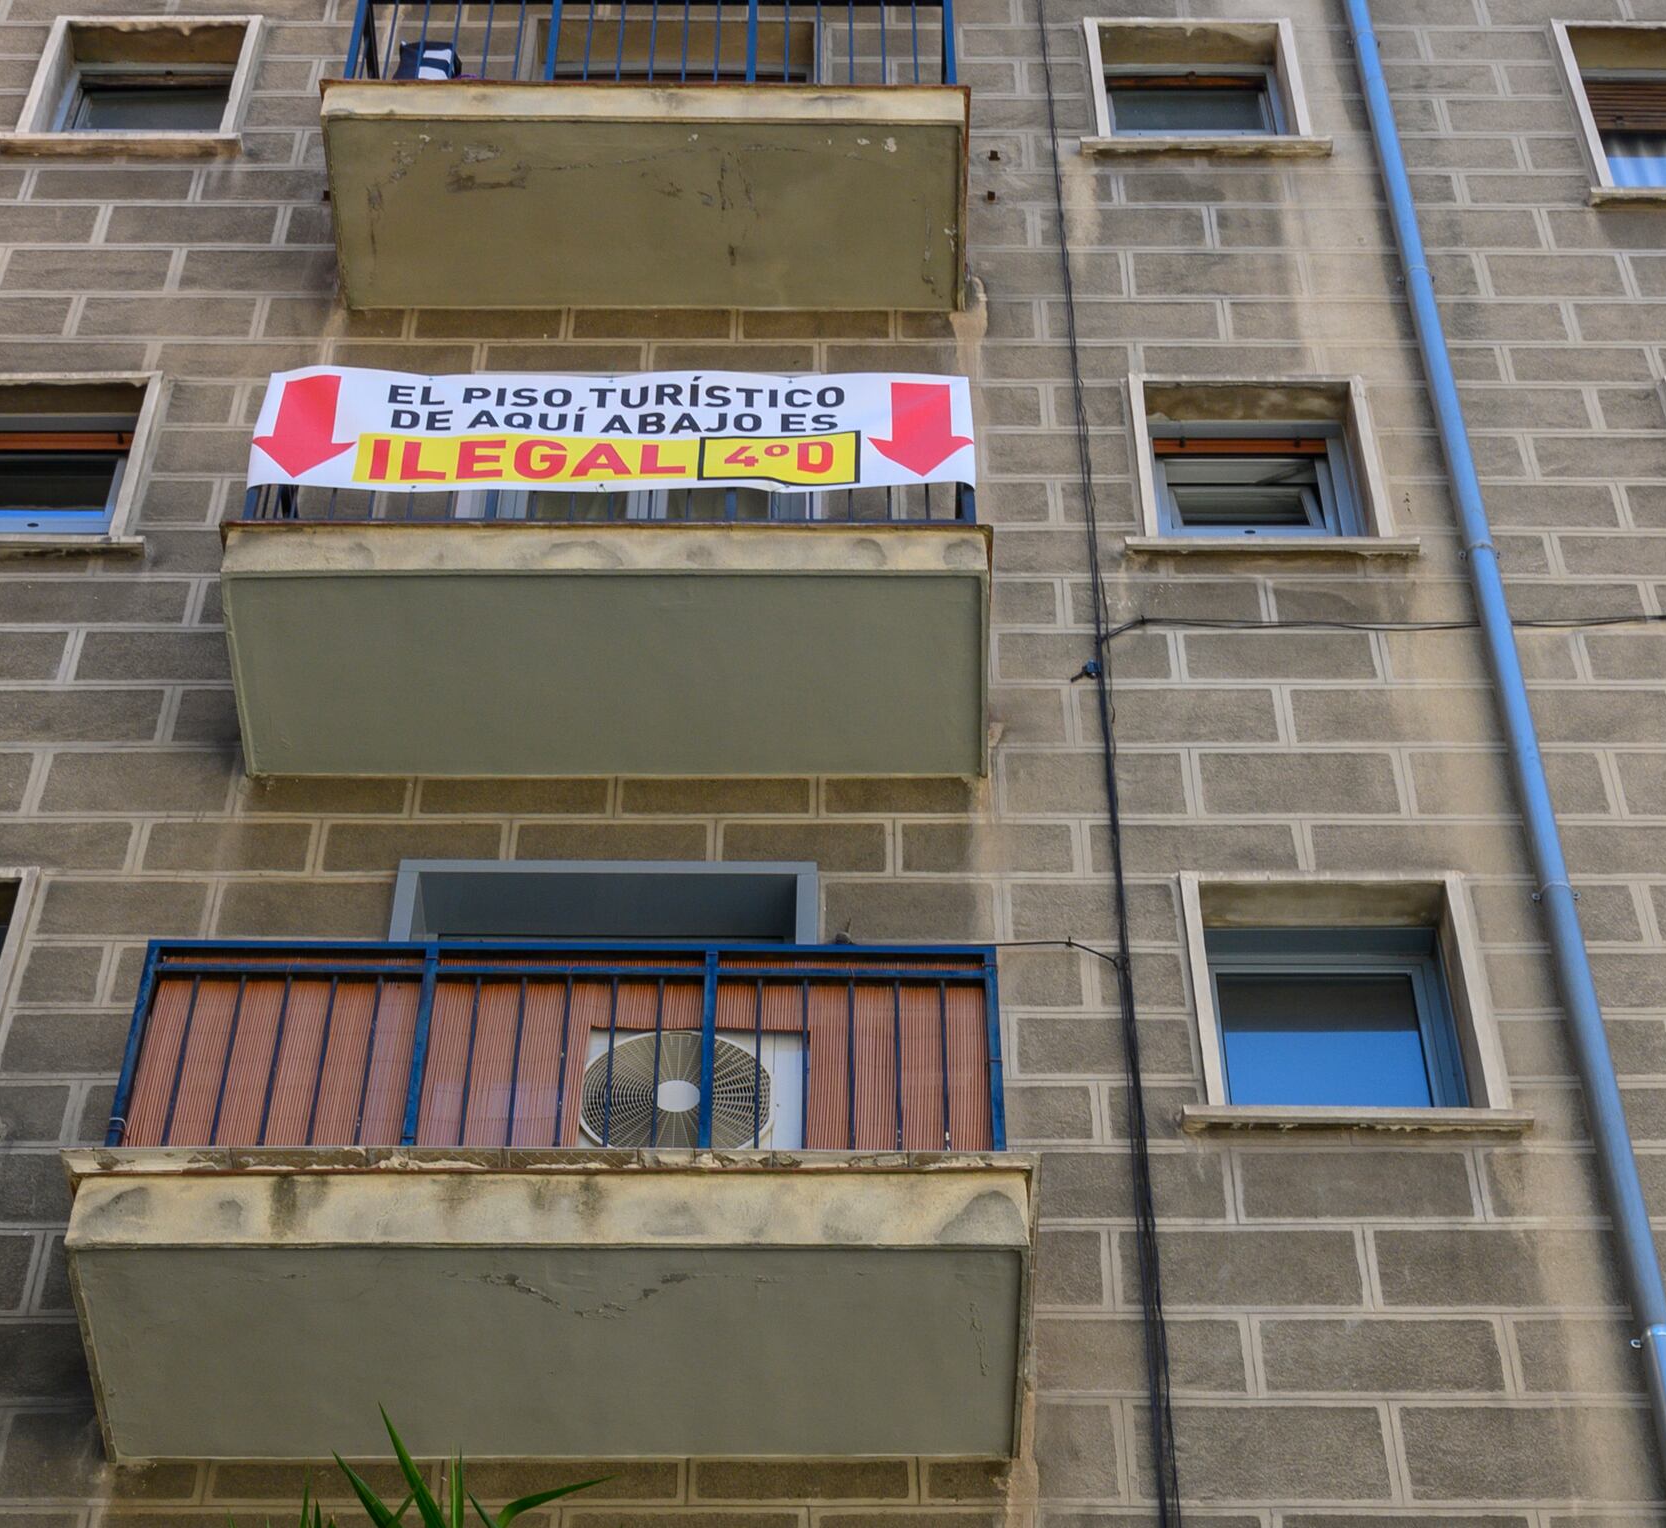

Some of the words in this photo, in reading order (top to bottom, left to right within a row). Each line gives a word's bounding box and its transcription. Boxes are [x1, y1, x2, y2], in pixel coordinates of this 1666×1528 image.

[387, 384, 446, 406] EL
[462, 387, 573, 408] PISO
[588, 376, 846, 409] TURÍSTICO
[390, 409, 454, 432] DE
[467, 406, 585, 433] AQUÍ
[600, 411, 763, 435] ABAJO
[780, 413, 839, 433] ES
[368, 439, 687, 482] ILEGAL
